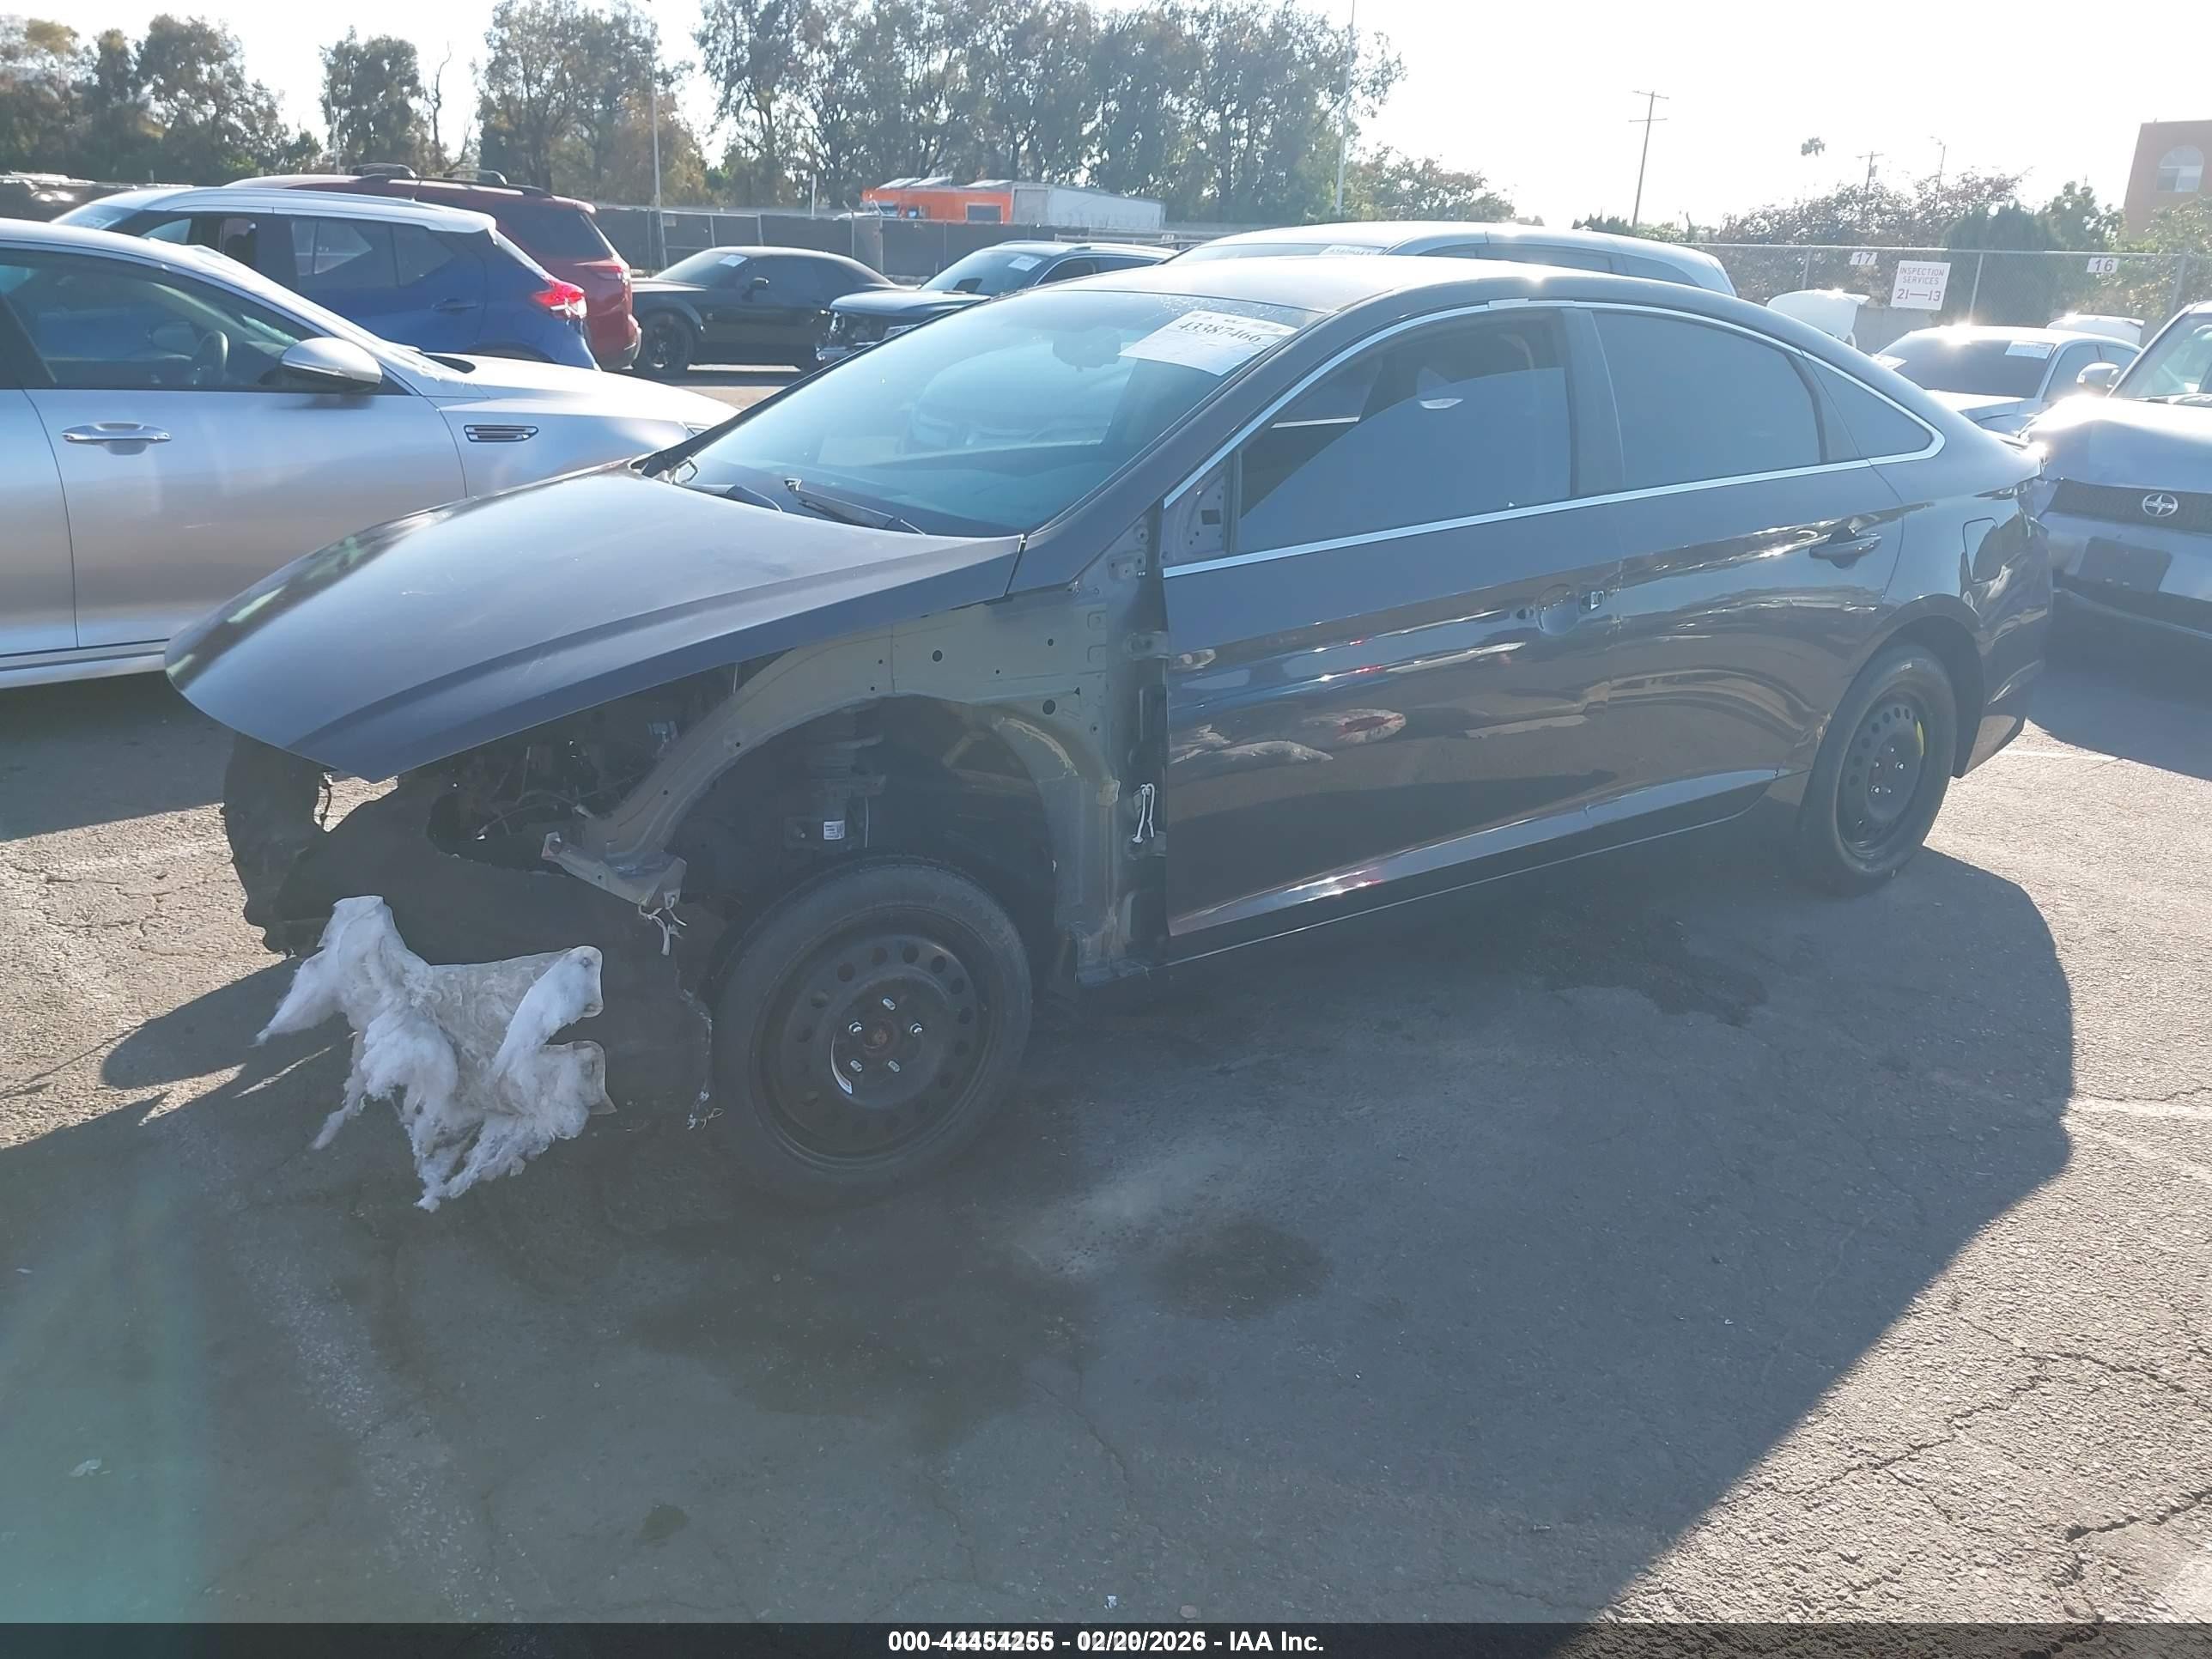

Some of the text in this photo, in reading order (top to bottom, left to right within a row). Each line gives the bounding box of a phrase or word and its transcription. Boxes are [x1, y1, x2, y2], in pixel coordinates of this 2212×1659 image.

[1856, 252, 1873, 264] 17
[2095, 258, 2114, 271] 16
[1899, 267, 1944, 276] INSPECTION
[1902, 276, 1939, 285] SERVICES
